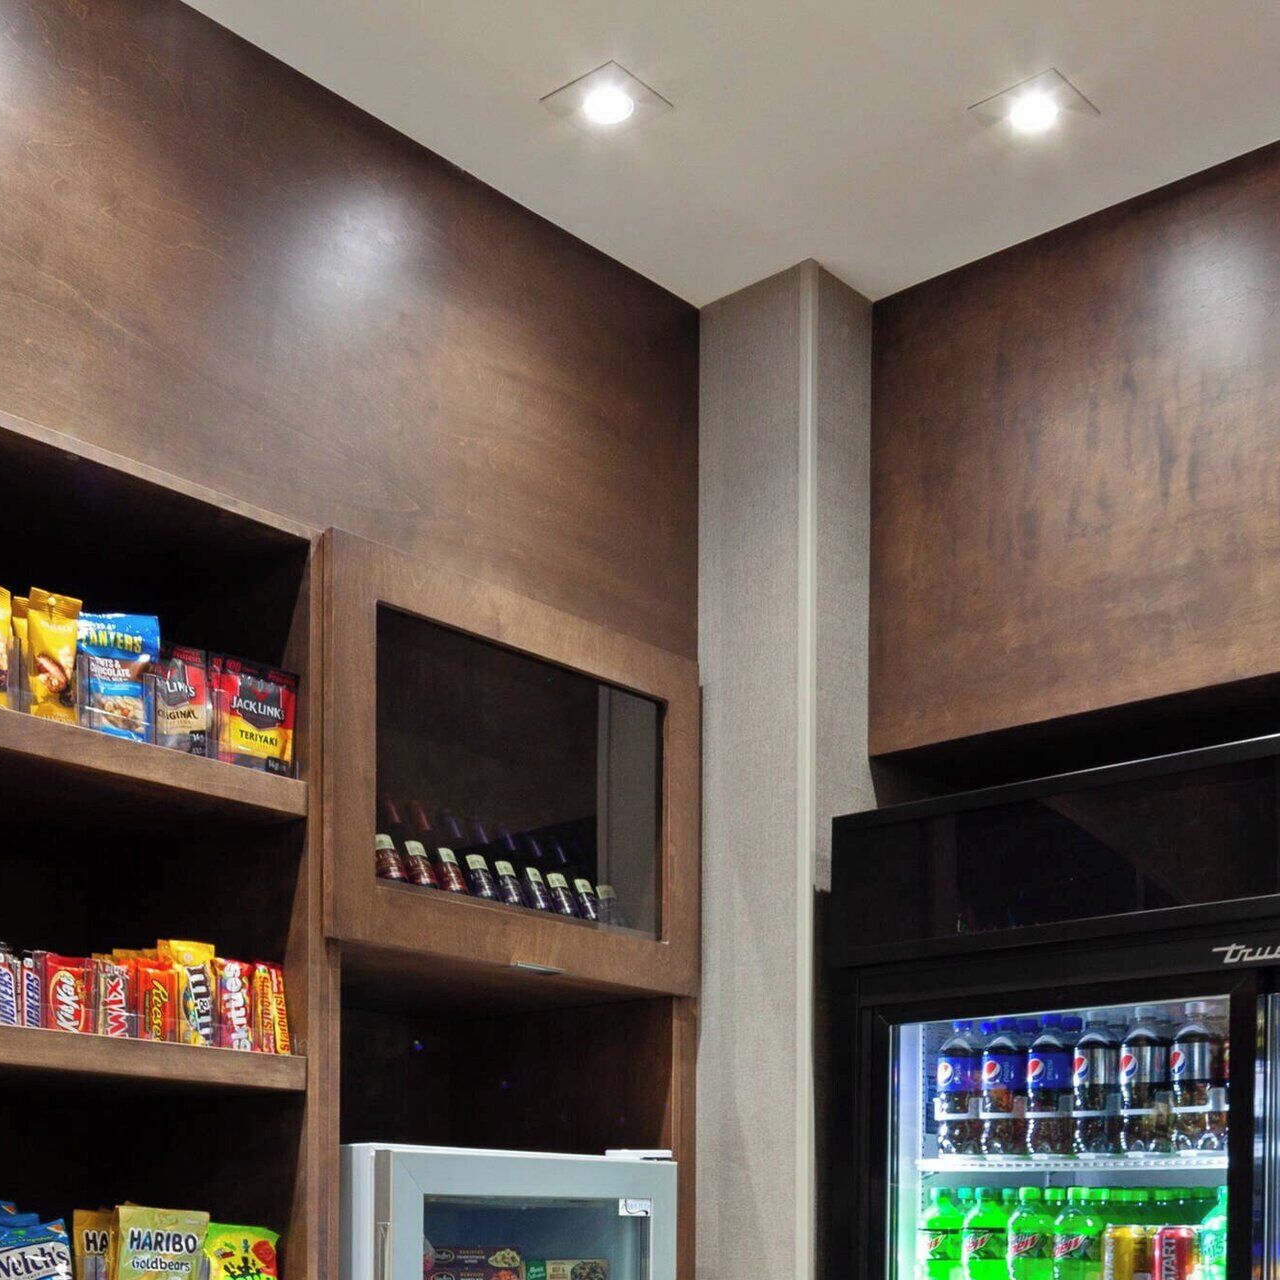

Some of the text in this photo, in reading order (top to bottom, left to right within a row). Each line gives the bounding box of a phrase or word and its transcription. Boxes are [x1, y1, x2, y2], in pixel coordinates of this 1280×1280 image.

[231, 696, 257, 714] JACK
[240, 729, 278, 746] TERIYAKI
[129, 1228, 199, 1255] HARIBO
[132, 1256, 191, 1273] Goldbears
